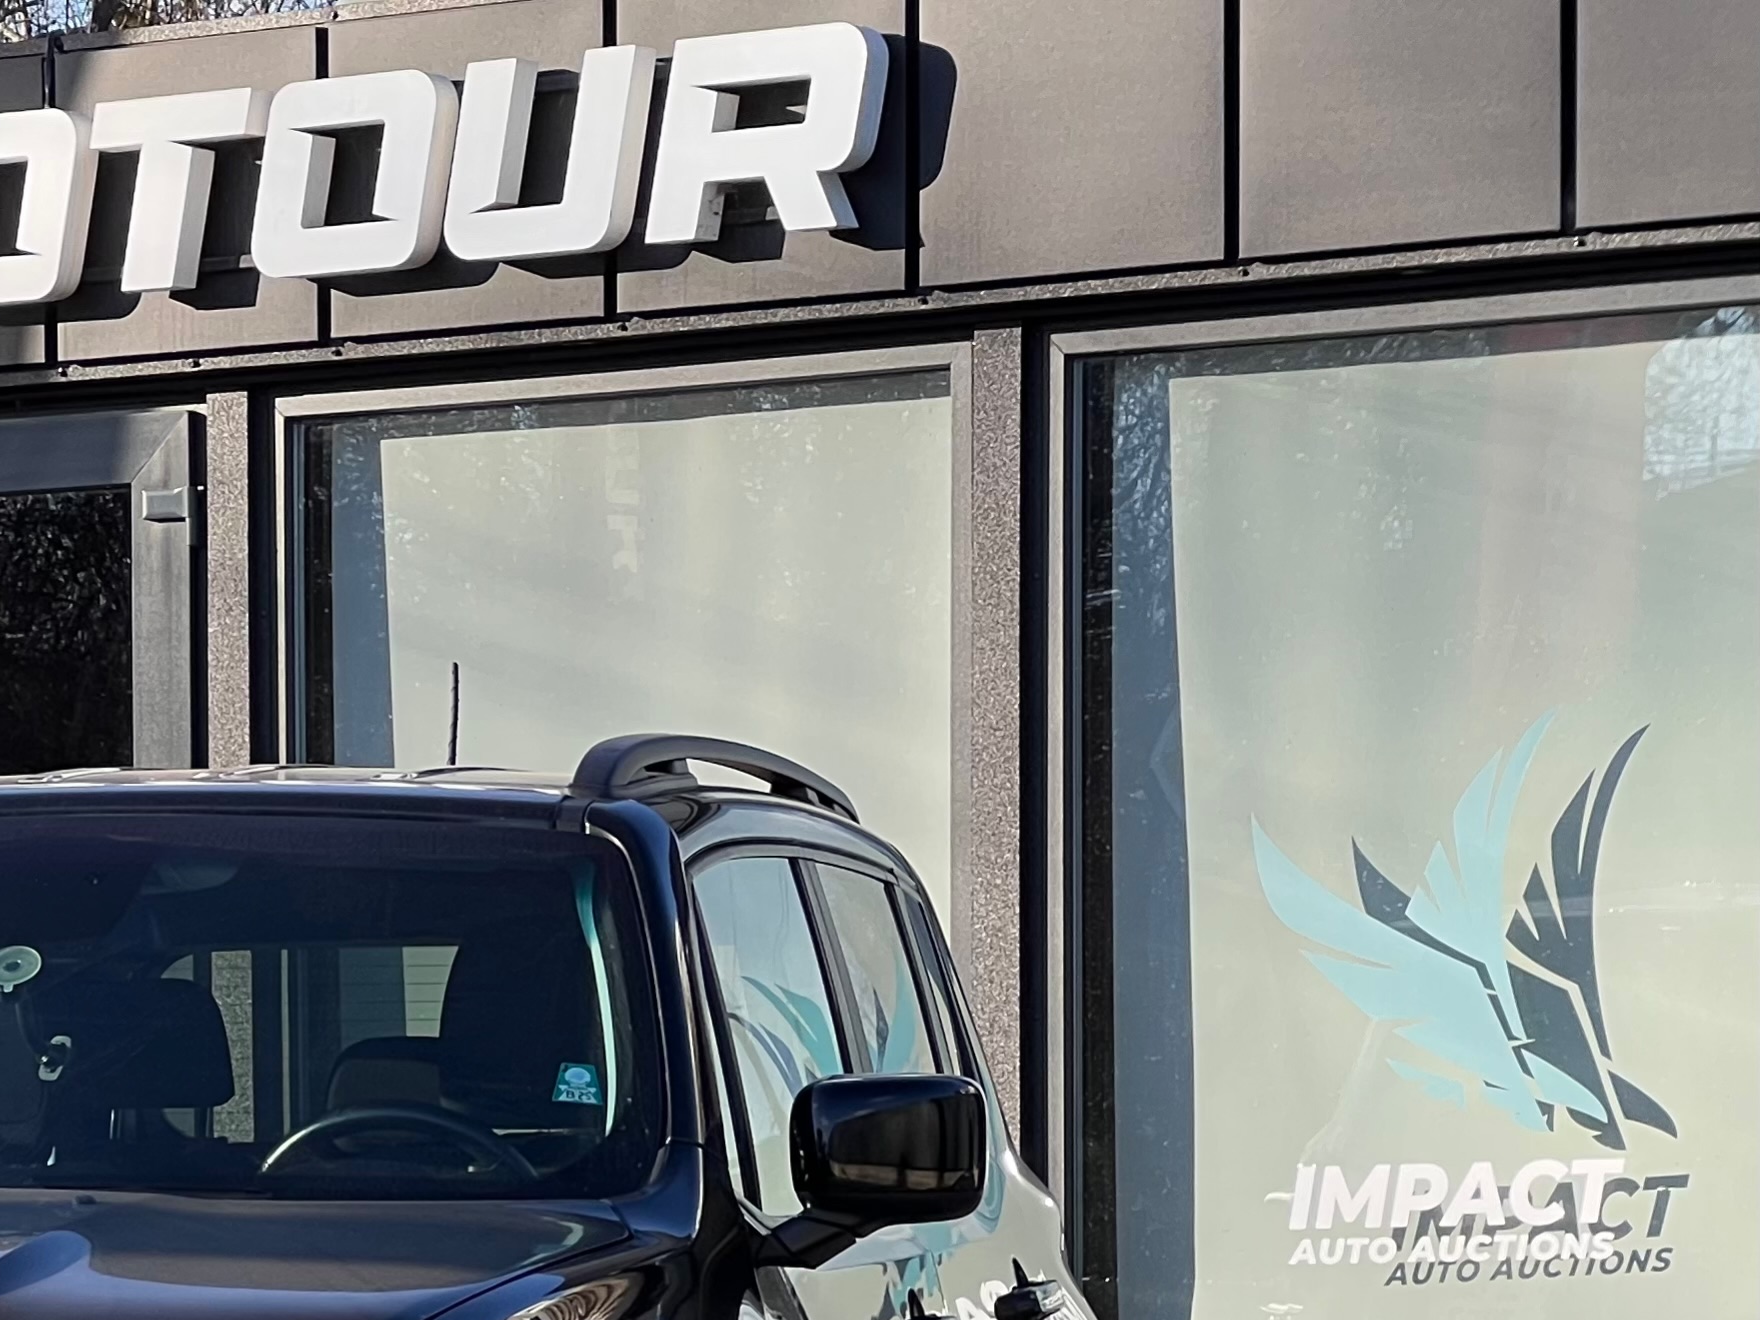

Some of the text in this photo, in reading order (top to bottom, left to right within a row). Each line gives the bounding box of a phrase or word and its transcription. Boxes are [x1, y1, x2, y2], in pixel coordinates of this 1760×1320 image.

[1289, 1158, 1625, 1231] IMPACT
[1288, 1231, 1616, 1266] AUTO AUCTIONS
